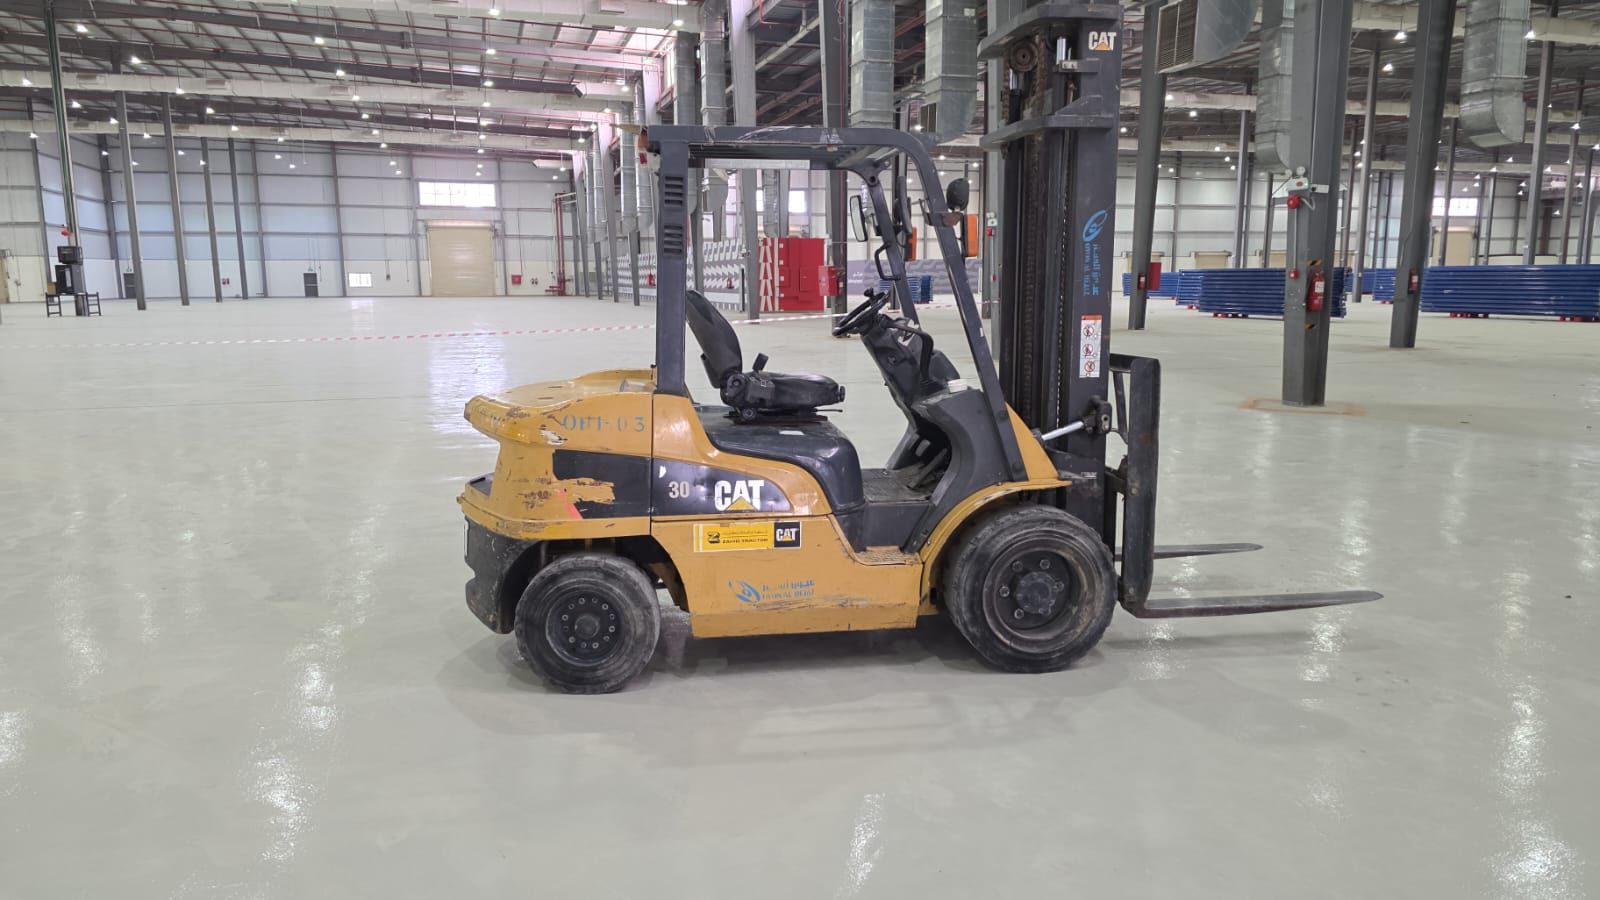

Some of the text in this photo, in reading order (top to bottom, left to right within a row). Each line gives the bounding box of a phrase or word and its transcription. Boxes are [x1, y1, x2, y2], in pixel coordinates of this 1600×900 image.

[1088, 31, 1117, 51] CAT
[668, 481, 690, 499] 30
[714, 479, 765, 511] CAT
[775, 528, 798, 542] CAT
